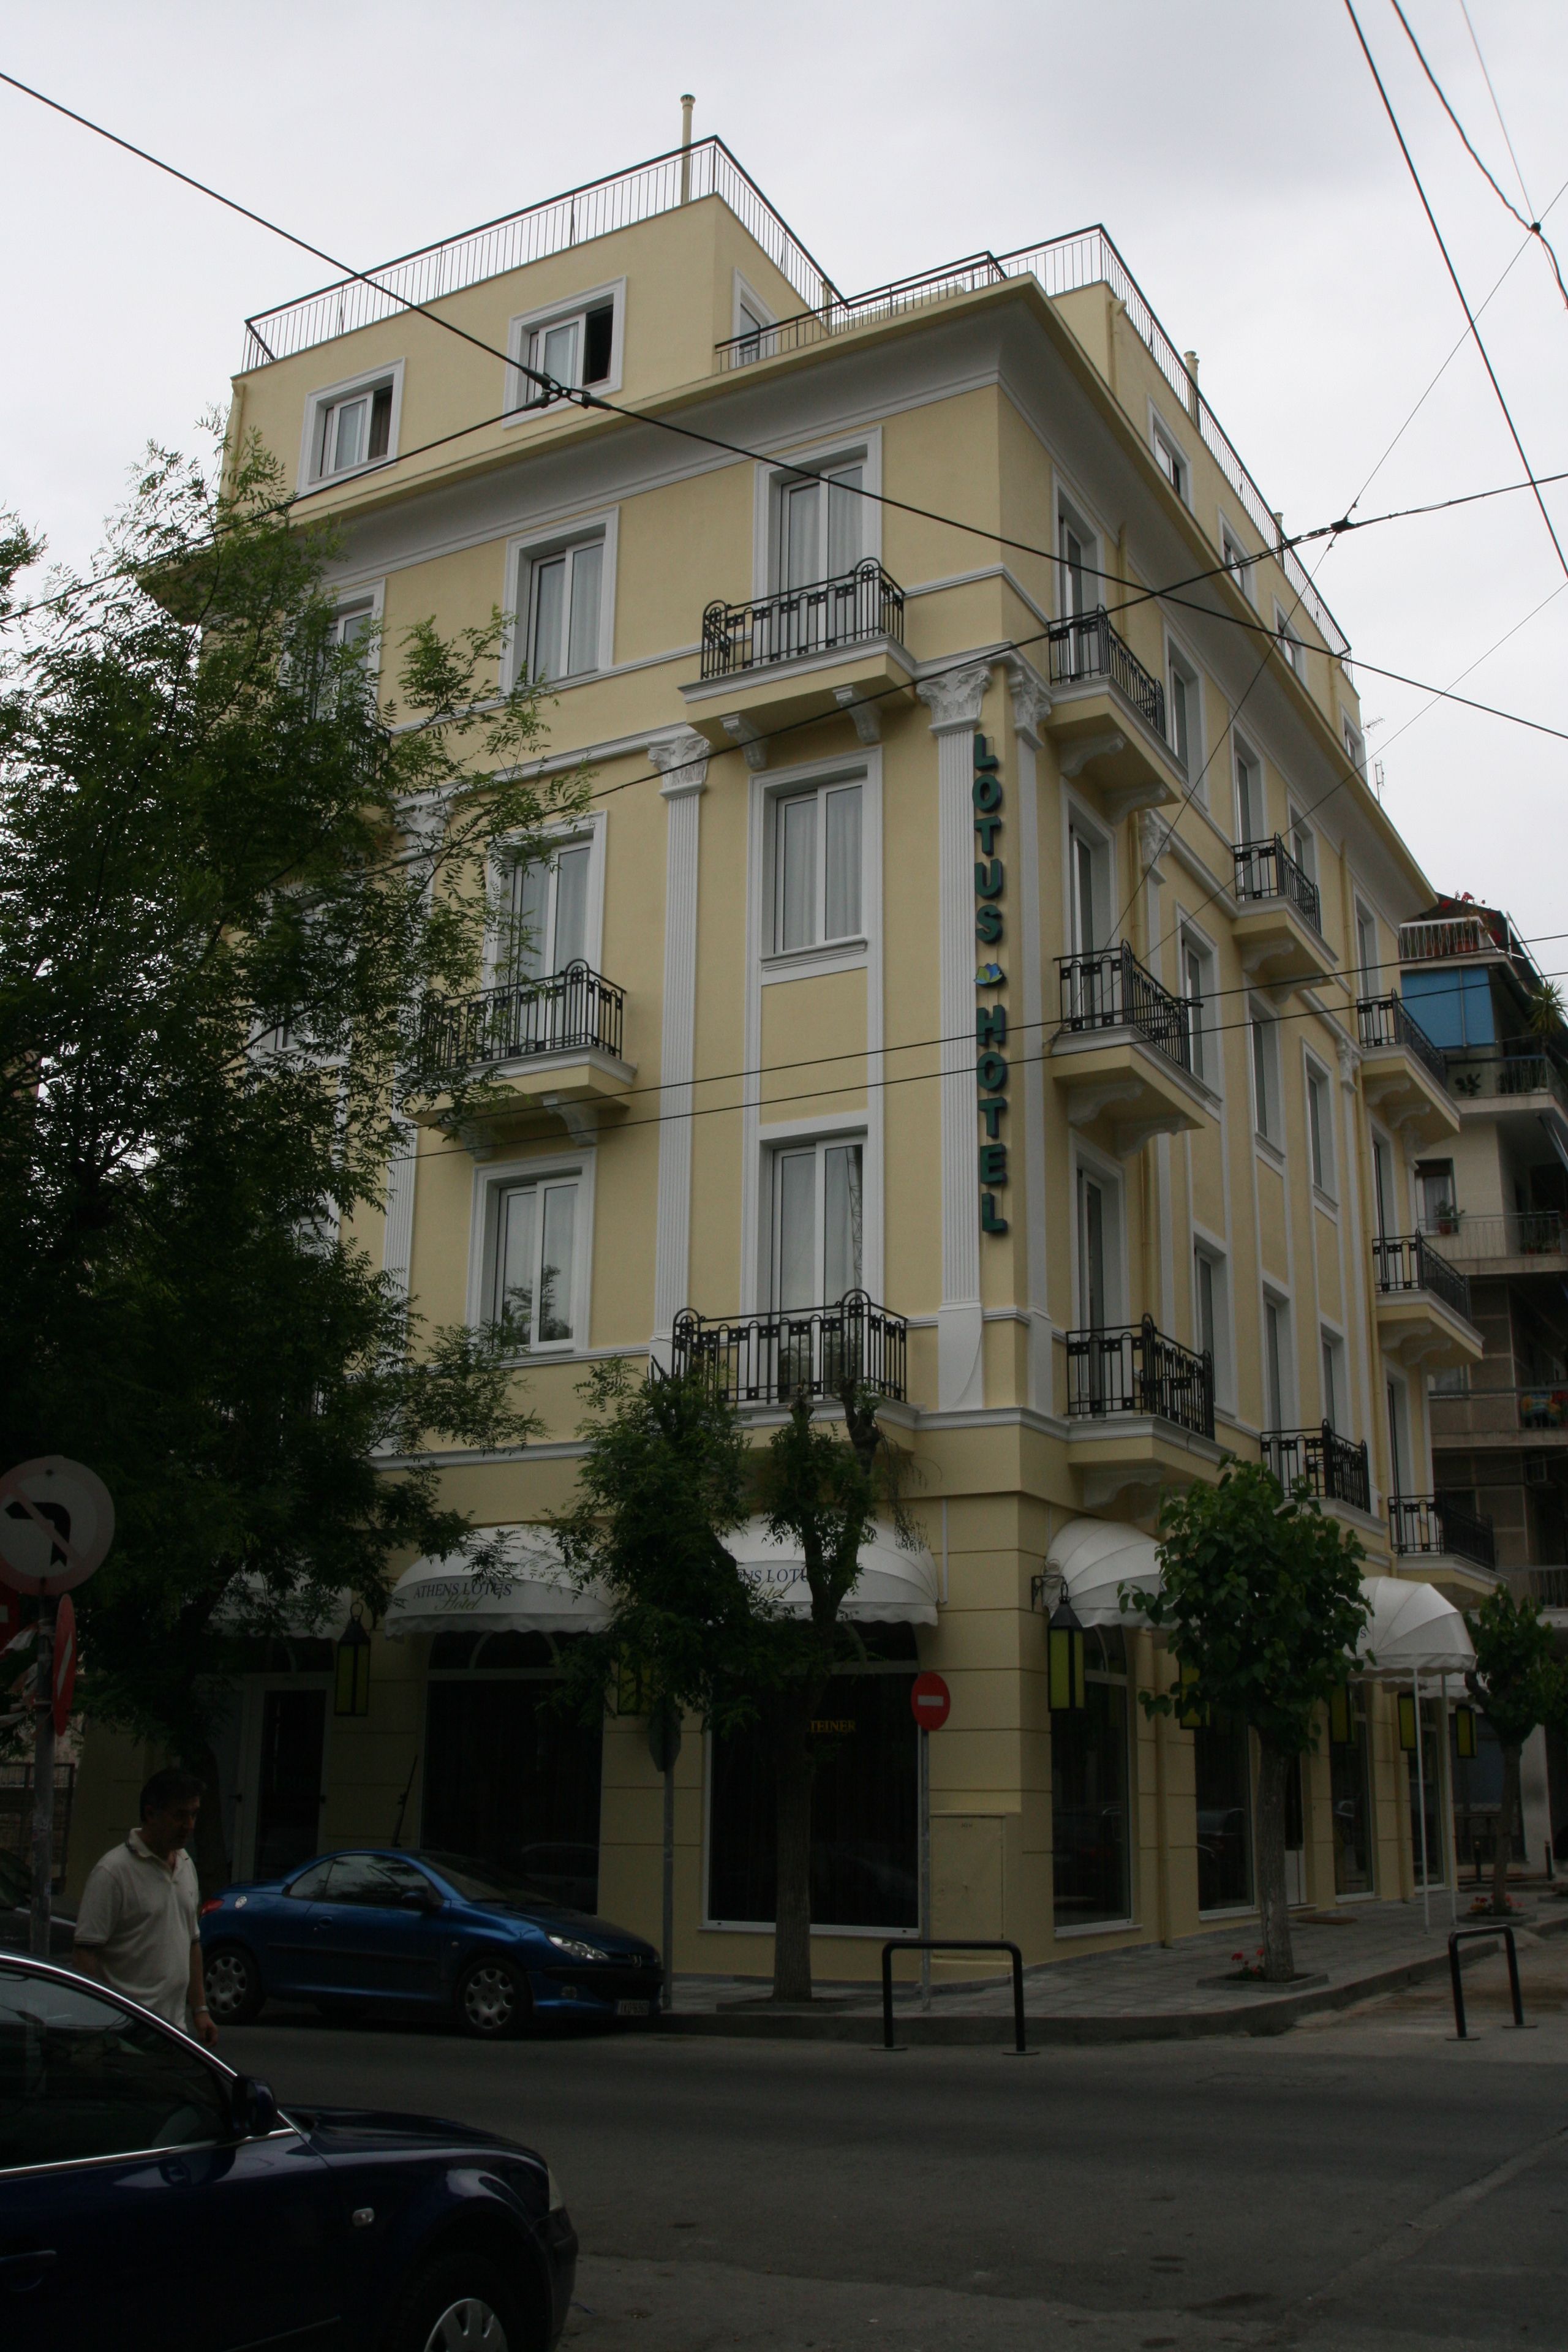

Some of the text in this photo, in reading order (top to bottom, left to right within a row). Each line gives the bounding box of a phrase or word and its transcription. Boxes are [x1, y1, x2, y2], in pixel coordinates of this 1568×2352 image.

[972, 733, 1008, 1232] LOTUS HOTEL
[767, 1569, 808, 1583] LOTU
[413, 1581, 512, 1599] ATHENS LOTUS
[434, 1593, 483, 1611] Hotel
[809, 1720, 856, 1732] TEINER
